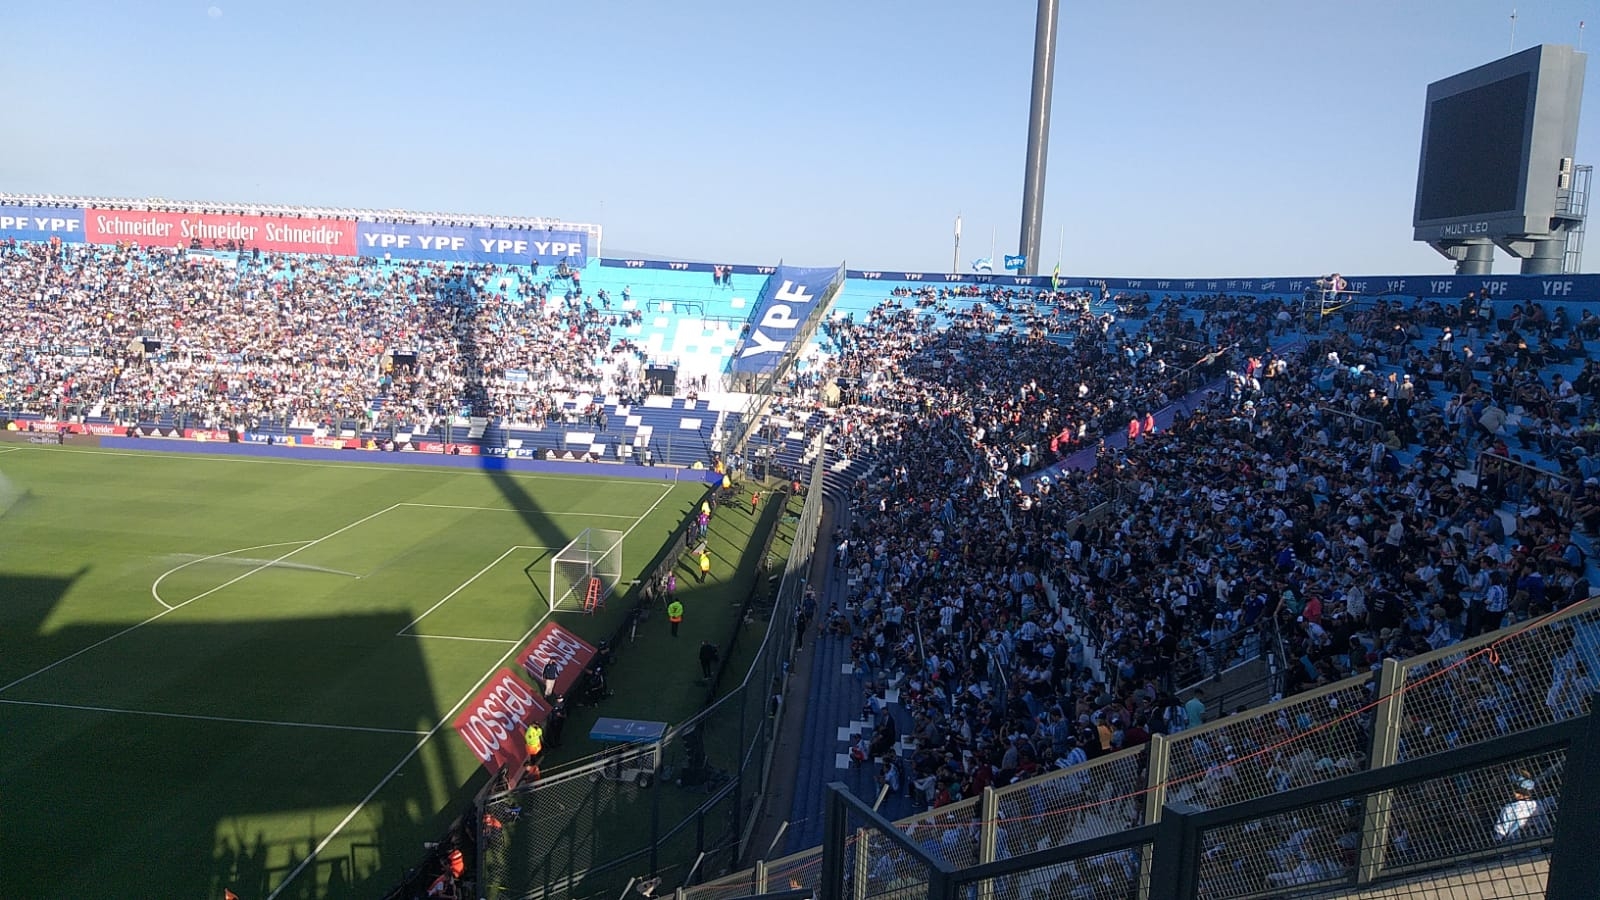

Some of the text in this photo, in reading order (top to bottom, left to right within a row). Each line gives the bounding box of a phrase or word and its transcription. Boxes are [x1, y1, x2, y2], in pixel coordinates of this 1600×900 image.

[34, 218, 80, 232] YPF
[97, 215, 343, 246] Schneider Schneider Schneider
[1470, 222, 1488, 233] LED
[364, 233, 582, 257] YPF YPF YPF YPF
[625, 260, 645, 268] YPF
[668, 262, 689, 270] YPF
[863, 272, 881, 280] YPF
[904, 273, 922, 281] YPF
[944, 274, 962, 282] YPF
[974, 275, 993, 283] YPF
[1014, 277, 1032, 285] YPF
[1056, 279, 1069, 287] PF
[1127, 280, 1142, 288] YPF
[1157, 281, 1170, 289] YPF
[1185, 281, 1195, 289] YPF
[1207, 281, 1217, 290] YPF
[1227, 281, 1236, 289] YPF
[1242, 281, 1253, 290] YPF
[1289, 280, 1303, 291] YPF
[1351, 281, 1367, 292] YPF
[1387, 279, 1406, 292] YPF
[1431, 280, 1453, 293] YPF
[1482, 280, 1508, 294] YPF
[1542, 280, 1573, 296] YPF
[741, 280, 815, 360] YPF
[487, 447, 509, 455] YPF
[460, 675, 545, 762] betsson
